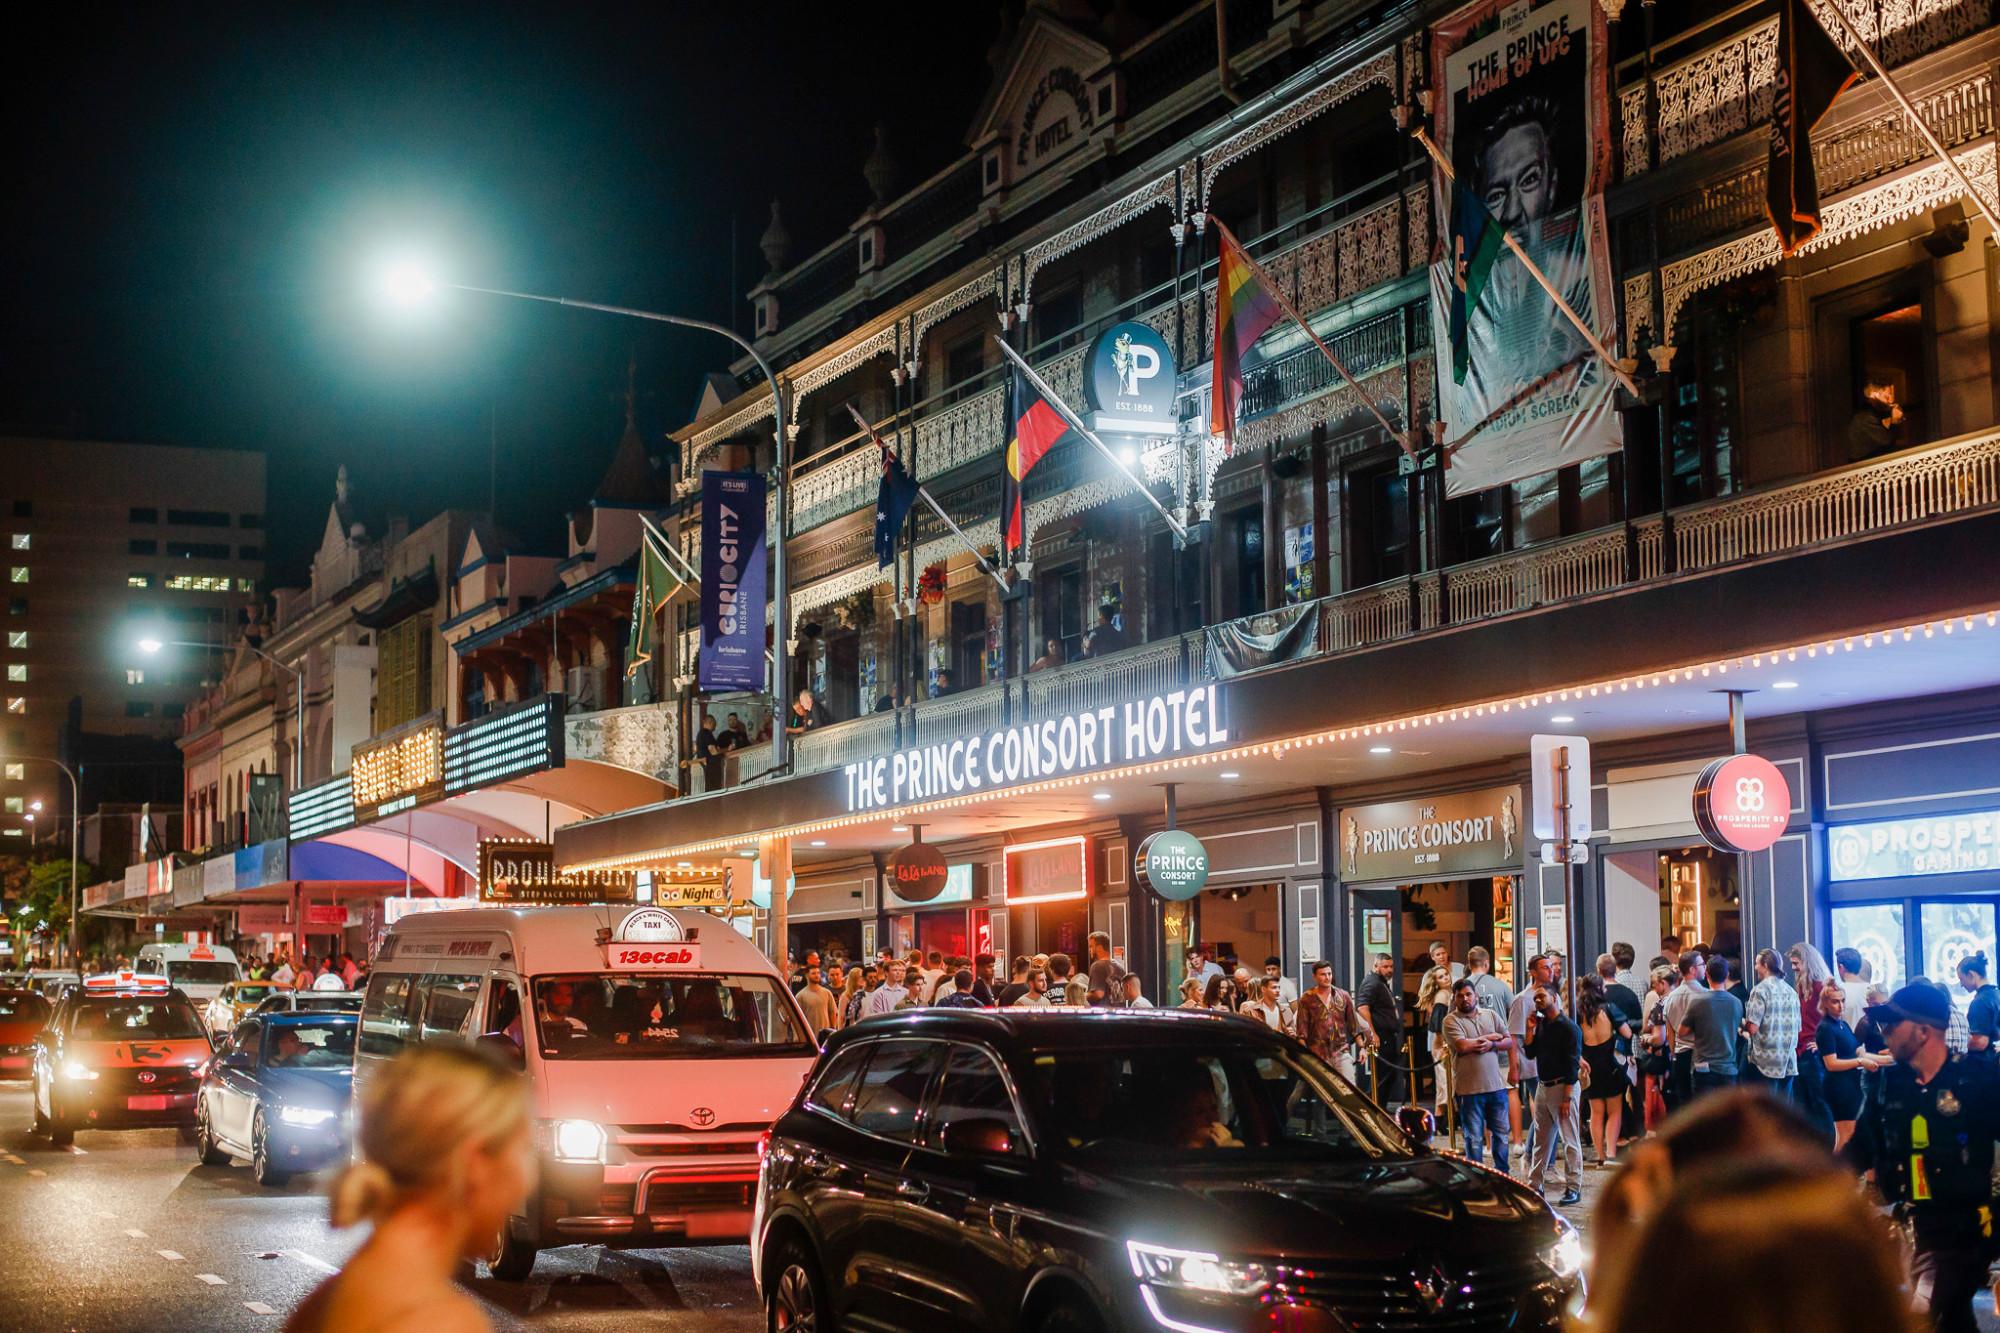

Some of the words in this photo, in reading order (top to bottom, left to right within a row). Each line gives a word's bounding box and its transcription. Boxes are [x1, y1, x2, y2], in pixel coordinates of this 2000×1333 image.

[1467, 68, 1509, 104] HOME
[1514, 57, 1533, 78] OF
[1539, 34, 1571, 66] UFC
[1468, 51, 1499, 86] THE
[1506, 14, 1569, 64] PRINCE
[1035, 116, 1073, 158] HOTEL
[1128, 344, 1160, 395] P
[1531, 391, 1580, 420] SCREEN
[719, 504, 739, 636] CURIOCITY
[739, 591, 747, 635] BRISBANE
[845, 763, 887, 811] THE
[893, 736, 981, 803] PRINCE
[987, 705, 1115, 785] CONSORT
[1124, 684, 1228, 760] HOTEL
[1419, 806, 1436, 820] THE
[1170, 846, 1186, 854] THE
[1363, 826, 1419, 854] PRINCE
[1421, 816, 1494, 848] CONSORT
[1871, 817, 2000, 855] PROSPE
[1152, 856, 1204, 870] PRINCE
[1160, 872, 1196, 880] CONSORT
[1913, 847, 1988, 872] GAMING
[644, 921, 661, 929] TAXI
[620, 949, 692, 963] 13ecab
